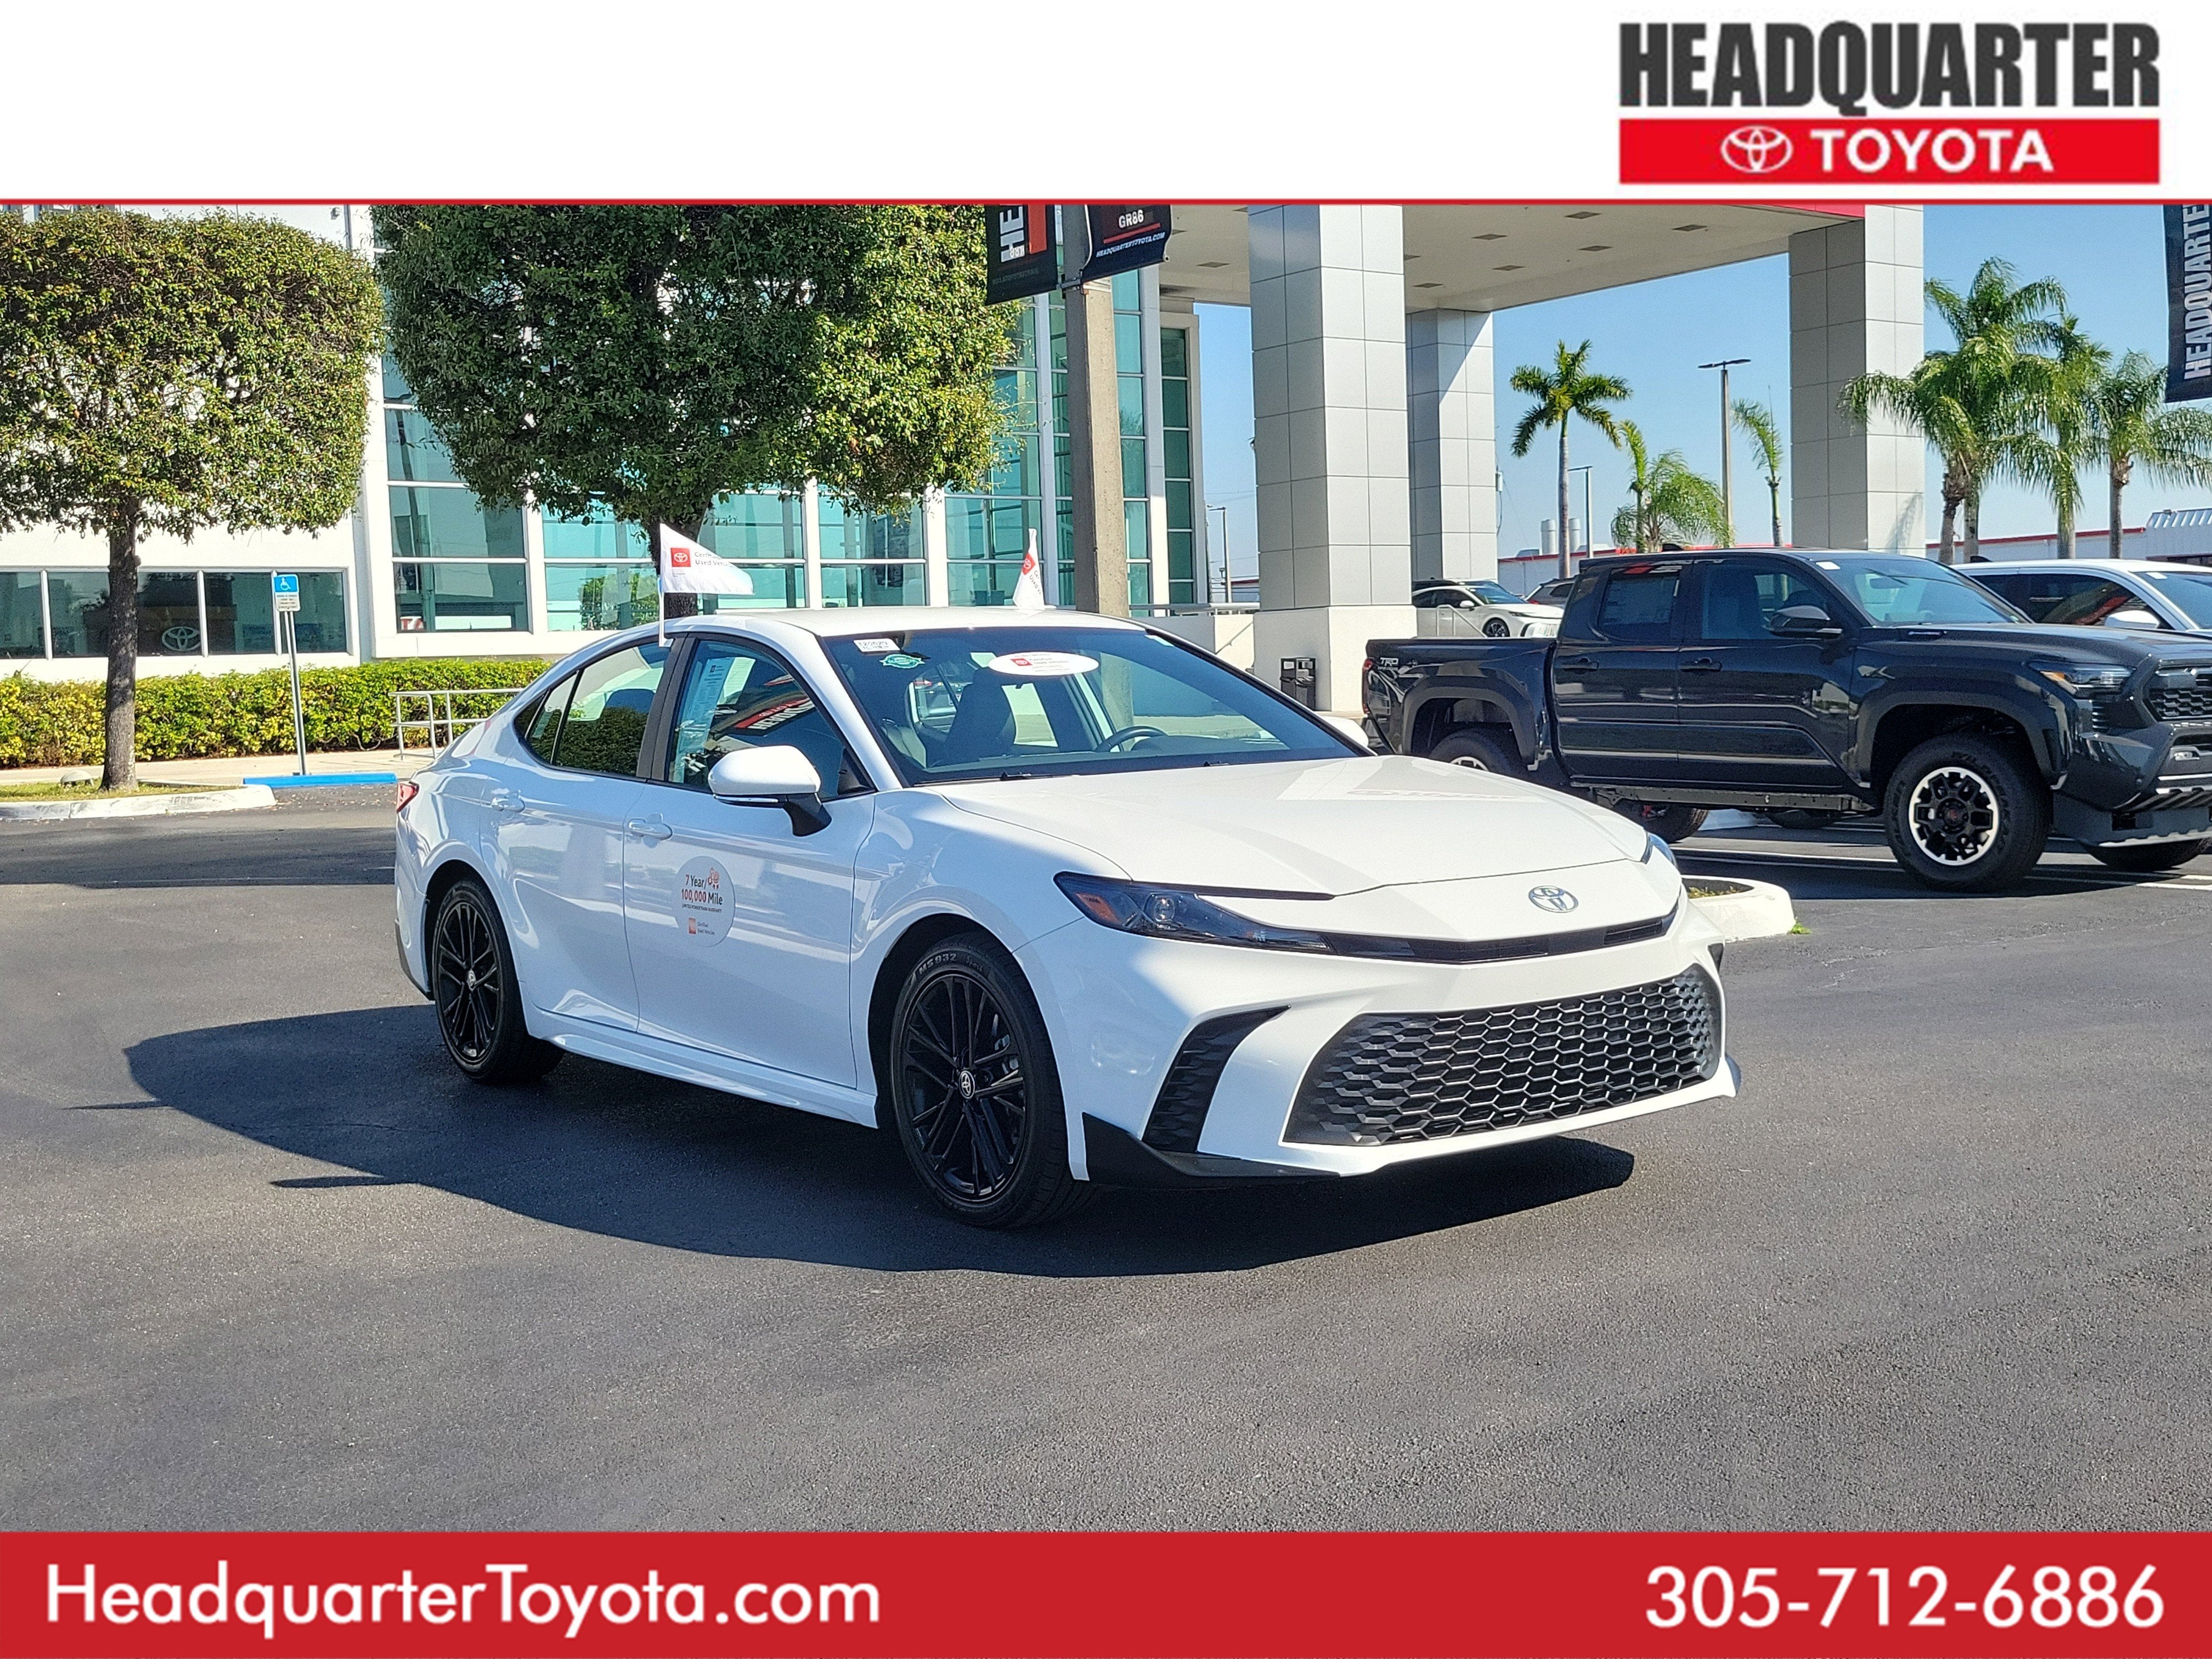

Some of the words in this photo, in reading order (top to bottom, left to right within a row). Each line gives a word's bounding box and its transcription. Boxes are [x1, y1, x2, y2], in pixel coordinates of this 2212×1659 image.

[1118, 209, 1144, 228] GR86
[999, 205, 1025, 263] HE
[2183, 205, 2212, 380] HEADQUARTE
[1380, 657, 1399, 667] TRD
[685, 874, 690, 885] 7
[690, 875, 707, 889] Year/
[681, 889, 707, 903] 100,000
[708, 893, 723, 905] Mile
